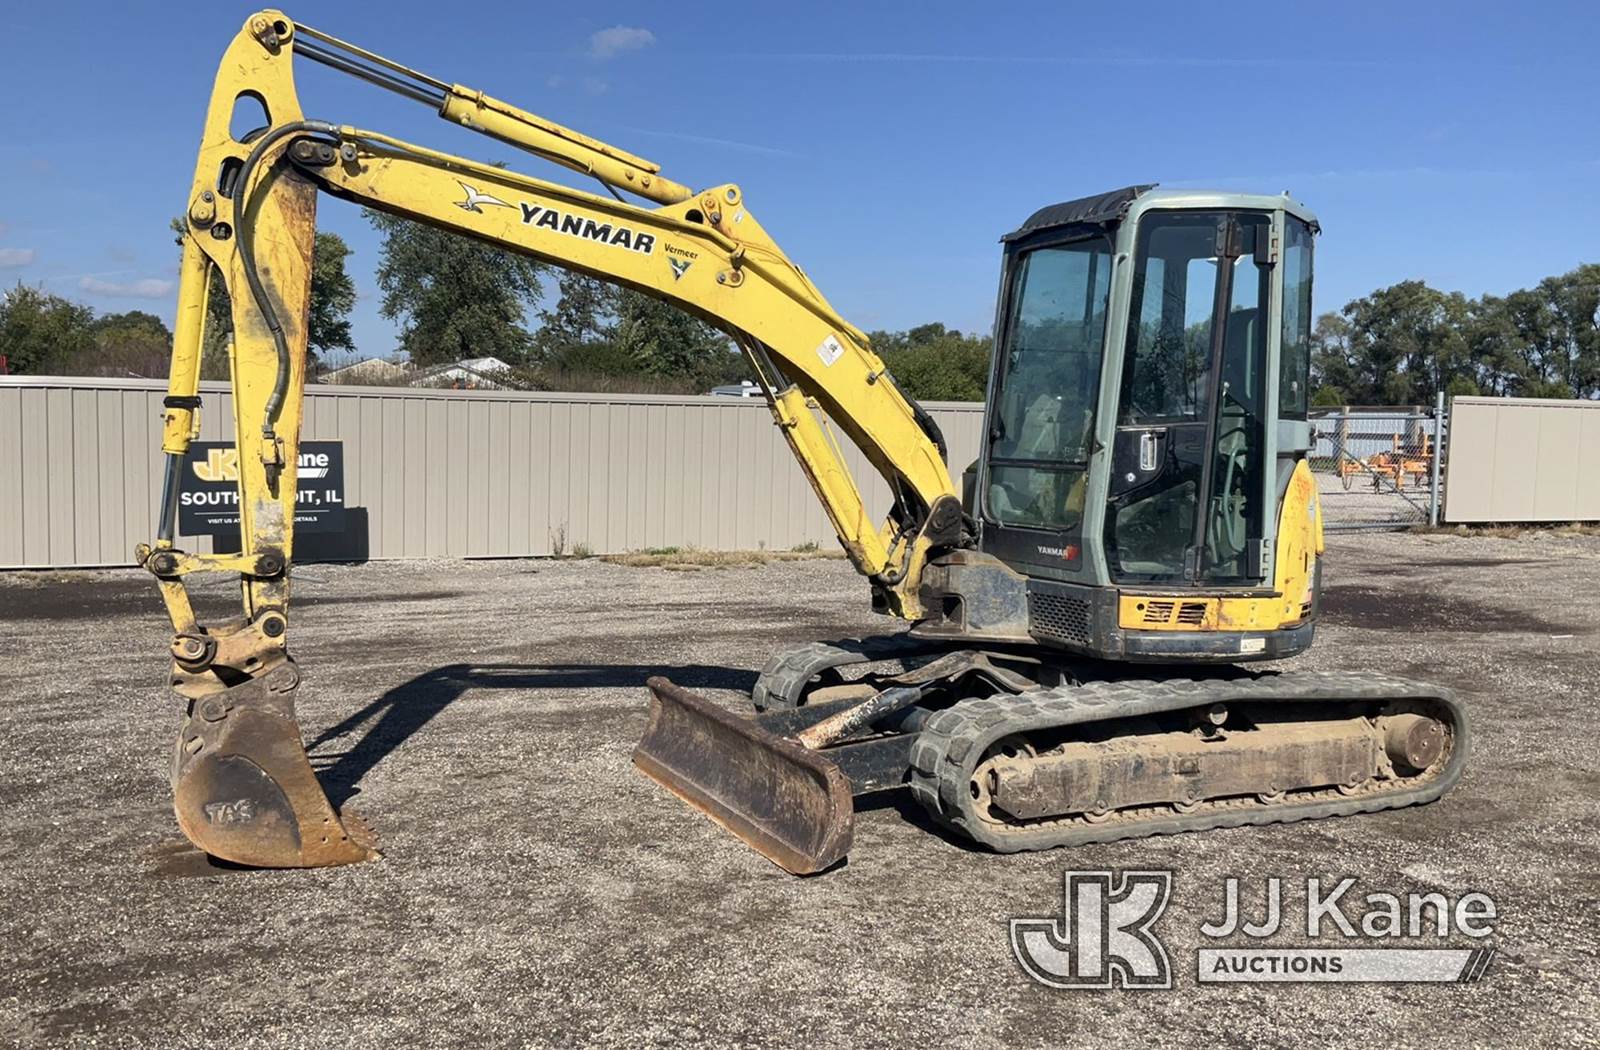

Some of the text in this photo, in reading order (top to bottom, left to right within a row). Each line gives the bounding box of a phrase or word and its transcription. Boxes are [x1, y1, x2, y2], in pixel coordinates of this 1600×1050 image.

[519, 201, 657, 255] YANMAR
[664, 242, 698, 260] Vermeer
[181, 491, 241, 506] SOUTH
[325, 489, 342, 503] IL
